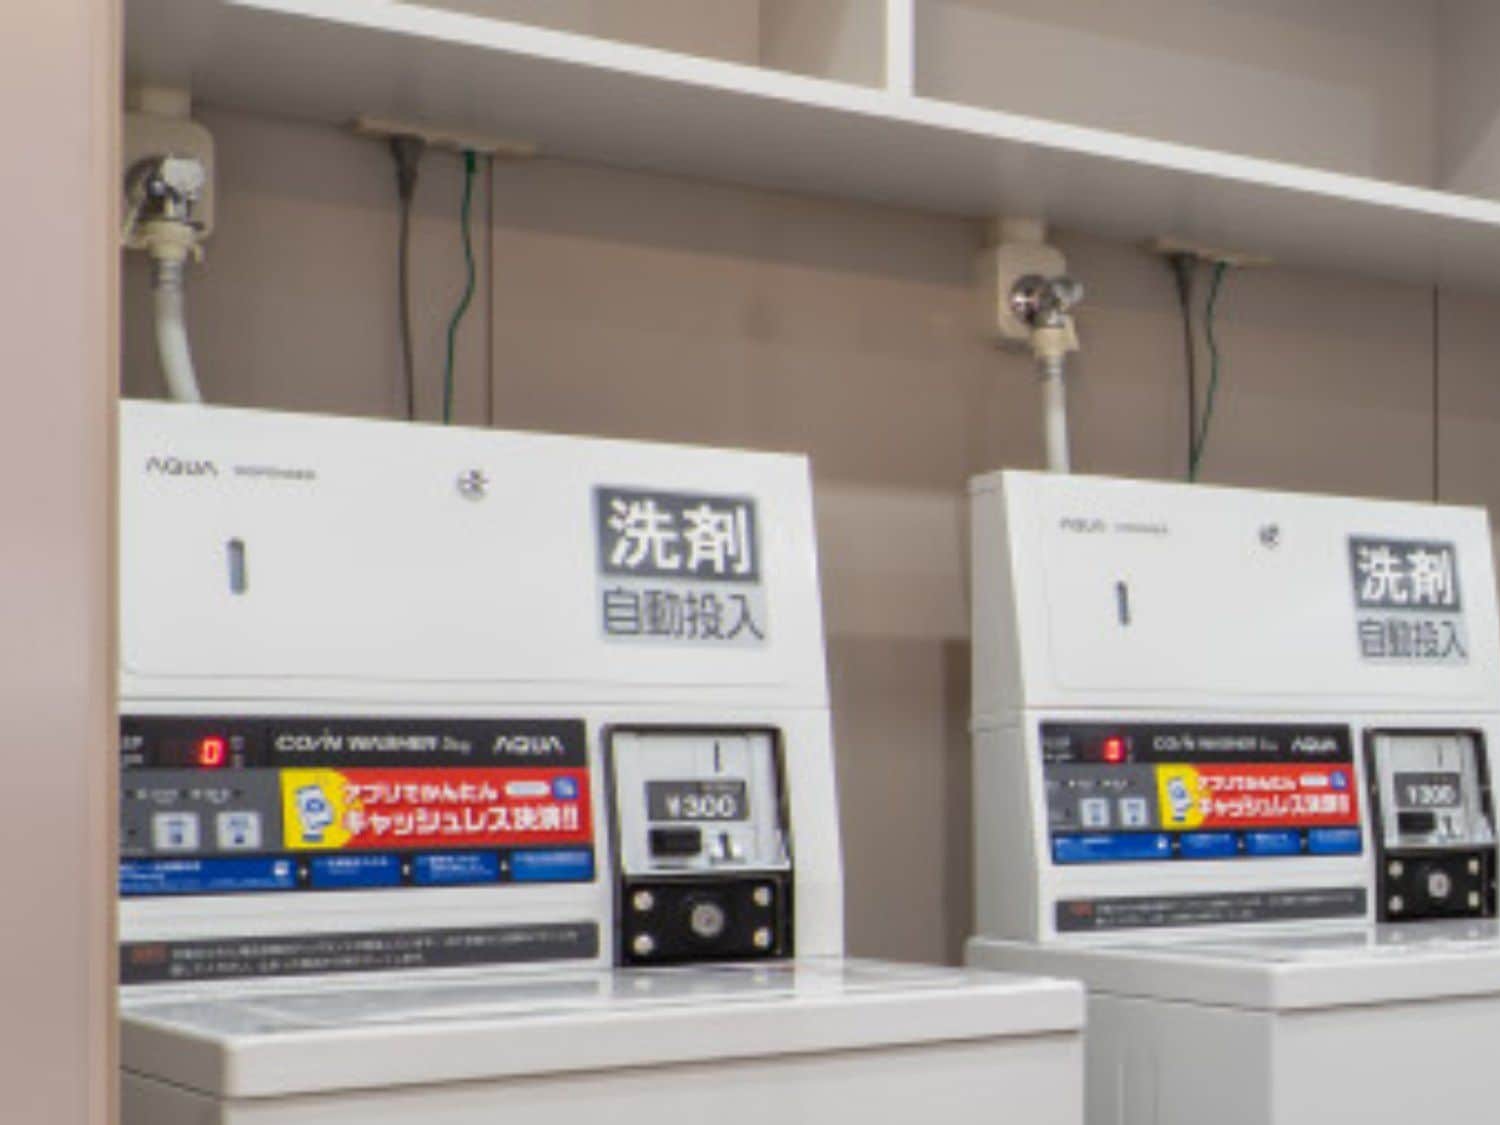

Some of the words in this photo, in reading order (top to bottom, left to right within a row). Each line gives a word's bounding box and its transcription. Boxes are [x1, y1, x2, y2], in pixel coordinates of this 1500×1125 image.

[146, 456, 218, 477] AQUA
[608, 499, 751, 574] 洗剤
[1357, 544, 1453, 604] 洗剤
[603, 586, 765, 640] 自動投入
[492, 735, 565, 756] AQUA
